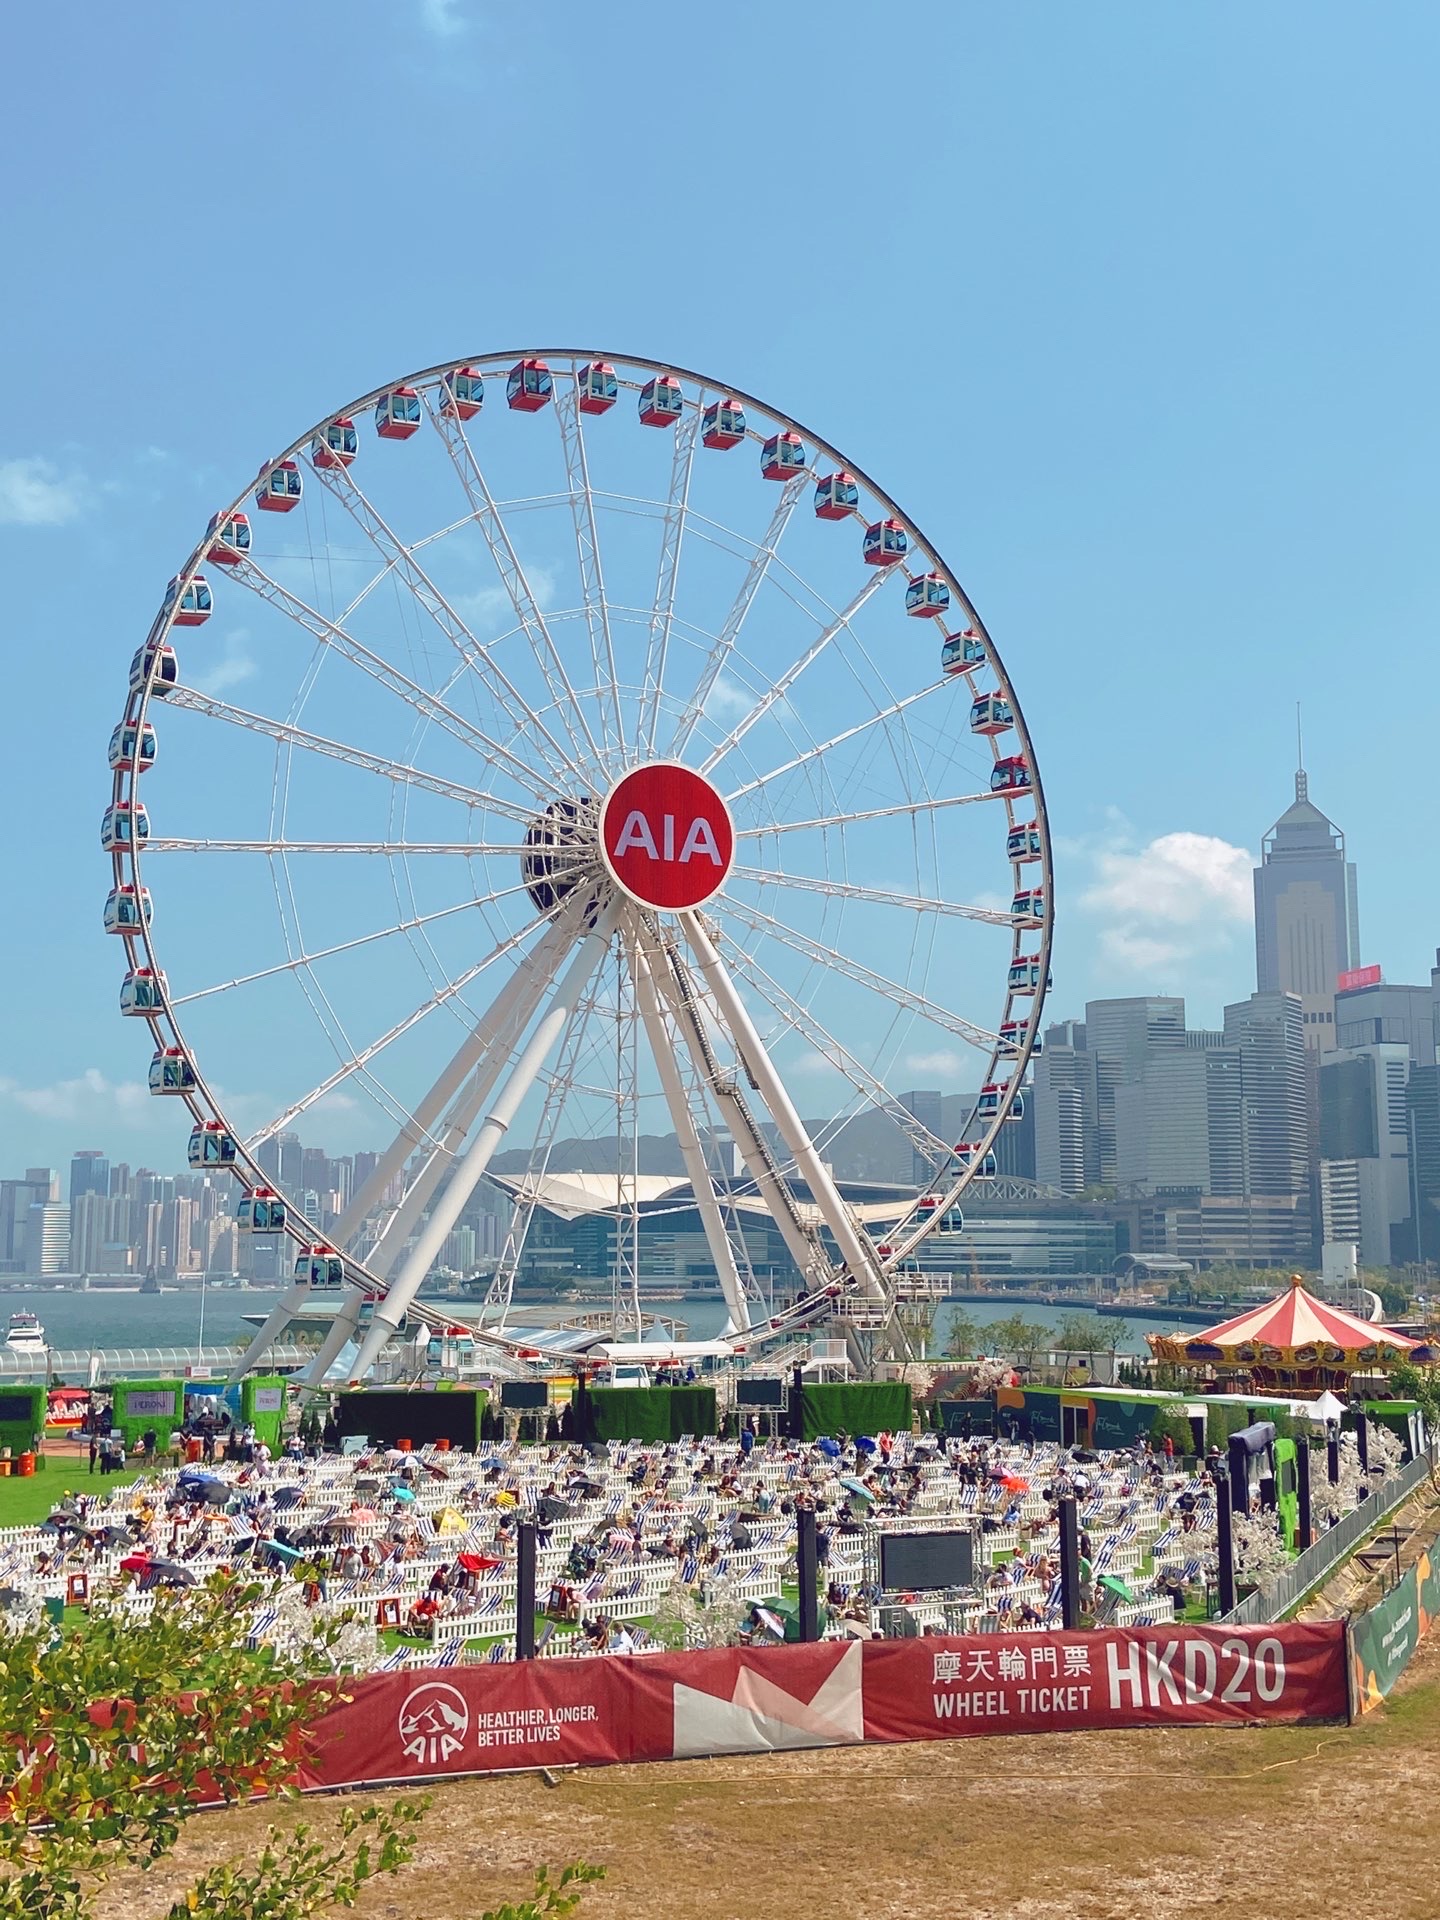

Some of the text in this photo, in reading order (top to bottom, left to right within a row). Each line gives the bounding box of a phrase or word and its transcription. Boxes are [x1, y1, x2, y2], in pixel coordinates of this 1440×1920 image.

[613, 810, 723, 866] AIA
[931, 1644, 1092, 1685] 摩天輪門票
[1106, 1637, 1287, 1710] HKD20
[478, 1705, 599, 1729] HEALTHIER, LONGER,
[933, 1685, 1092, 1719] WHEEL TICKET
[402, 1733, 465, 1764] AIA
[478, 1725, 561, 1747] BETTER LIVES
